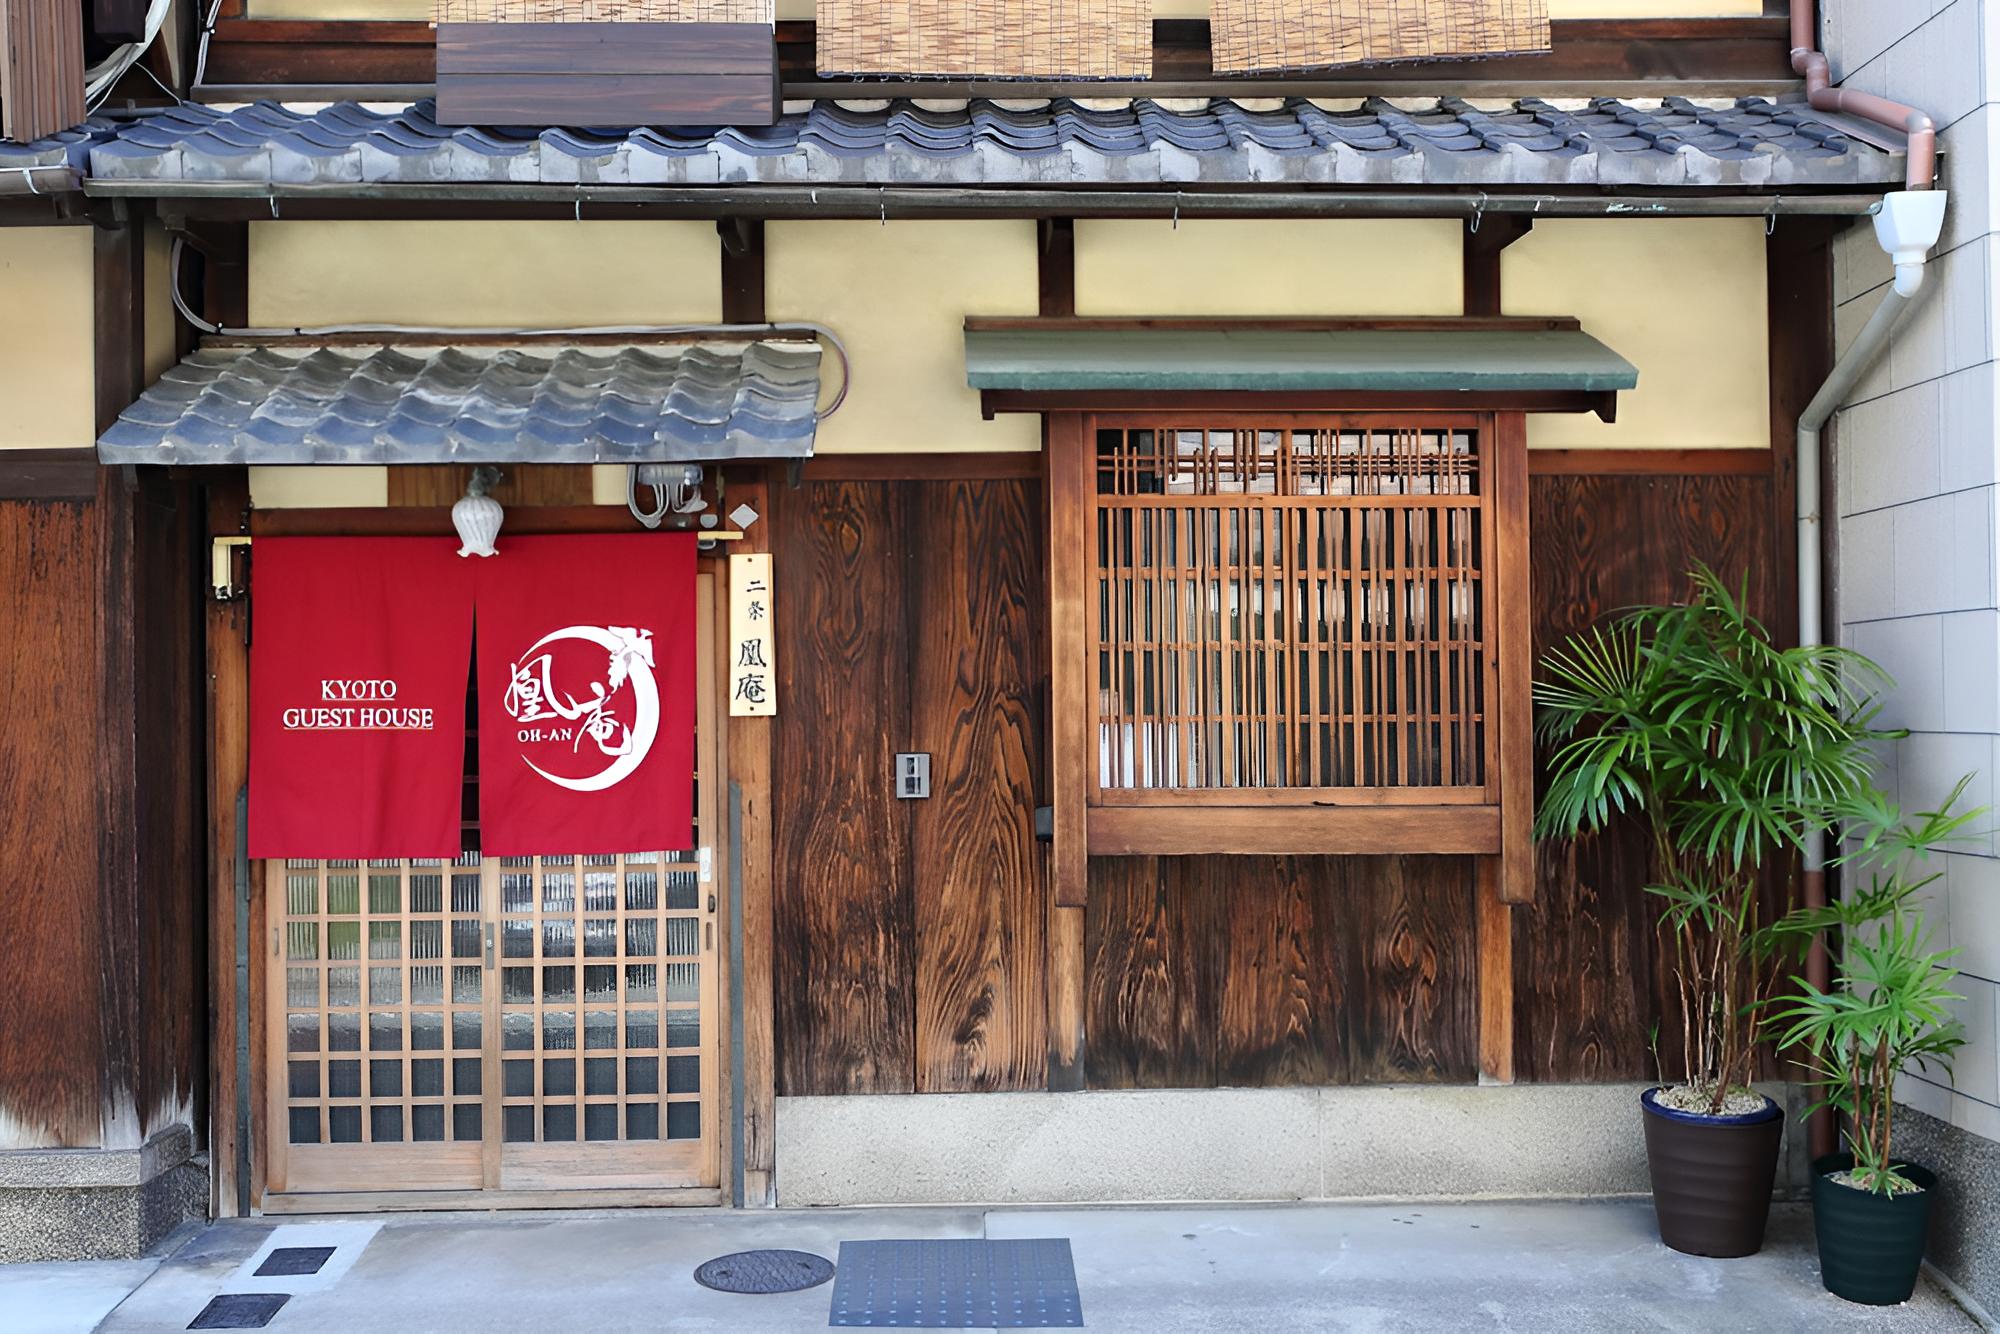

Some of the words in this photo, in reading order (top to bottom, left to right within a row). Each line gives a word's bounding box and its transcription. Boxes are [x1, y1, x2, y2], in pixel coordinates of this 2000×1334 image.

[321, 680, 397, 699] KYOTO
[283, 708, 355, 728] GUEST
[360, 708, 433, 728] HOUSE
[517, 728, 572, 743] OH-AN
